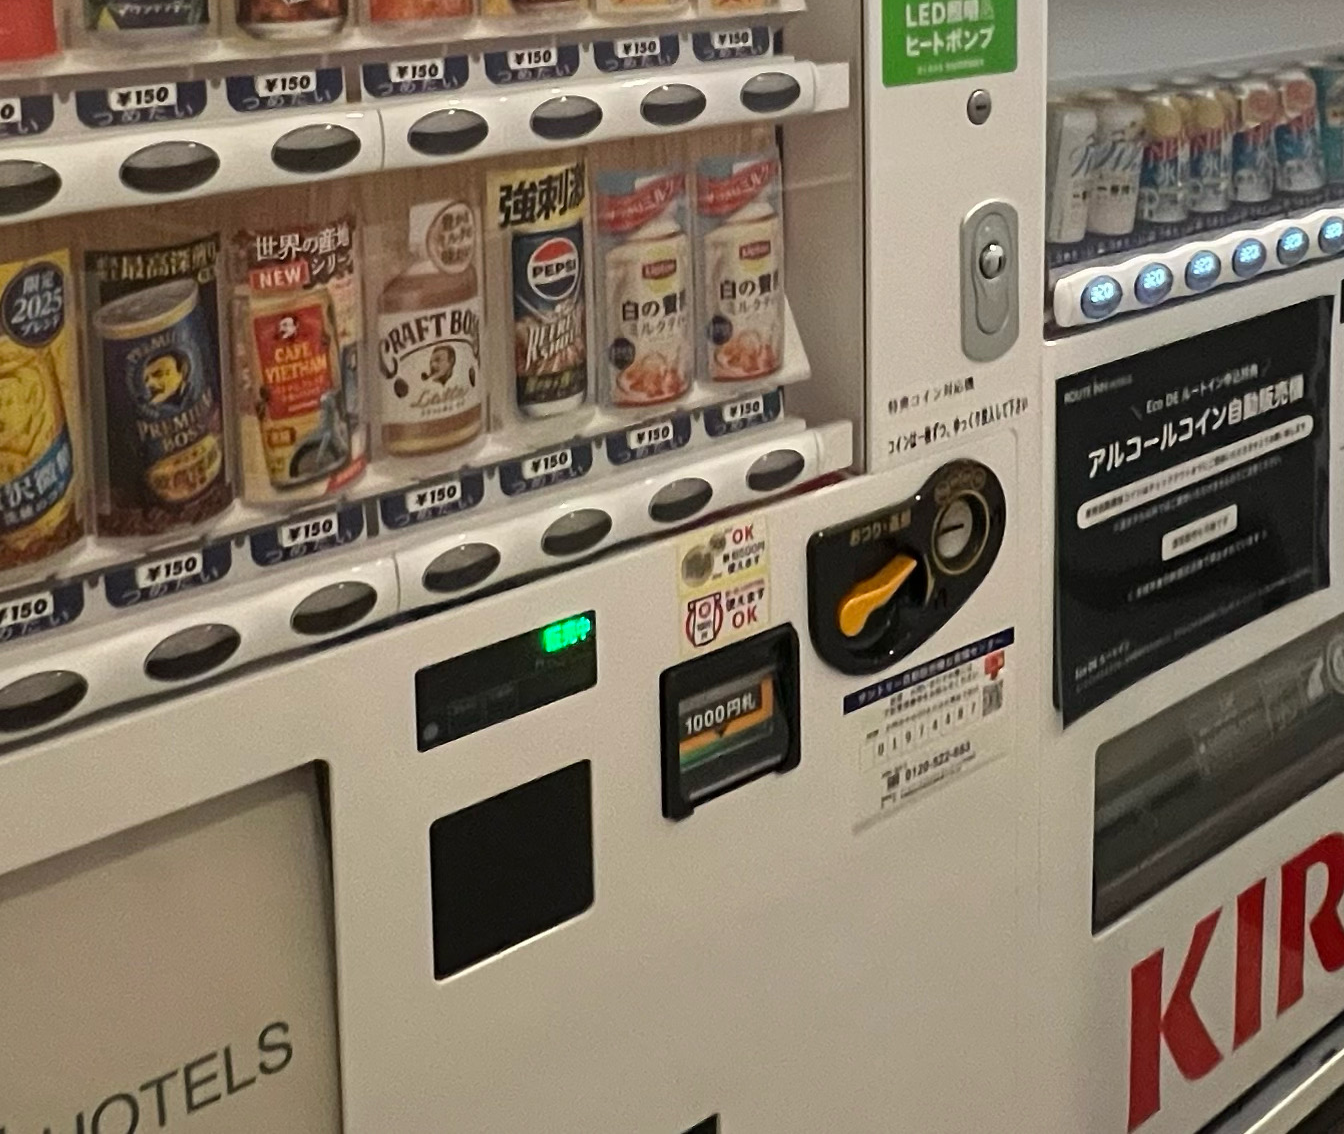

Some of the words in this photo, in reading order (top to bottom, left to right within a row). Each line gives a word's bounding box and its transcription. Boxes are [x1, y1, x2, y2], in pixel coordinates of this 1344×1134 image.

[905, 23, 996, 58] ヒートポンプ
[513, 50, 553, 65] ¥150
[264, 73, 312, 92] ¥150
[395, 62, 440, 79] ¥150
[115, 86, 171, 107] ¥150
[254, 223, 352, 263] 世界の産地
[258, 269, 306, 290] NEW
[11, 289, 64, 325] 2025
[379, 314, 448, 379] CRAFT
[1087, 372, 1305, 480] アルコールコイン自動販売機
[531, 450, 568, 473] ¥150
[415, 484, 458, 507] ¥150
[288, 518, 334, 542] ¥150
[731, 523, 754, 545] OK
[146, 556, 198, 583] ¥150
[731, 604, 758, 629] OK
[684, 691, 757, 737] 1000円札
